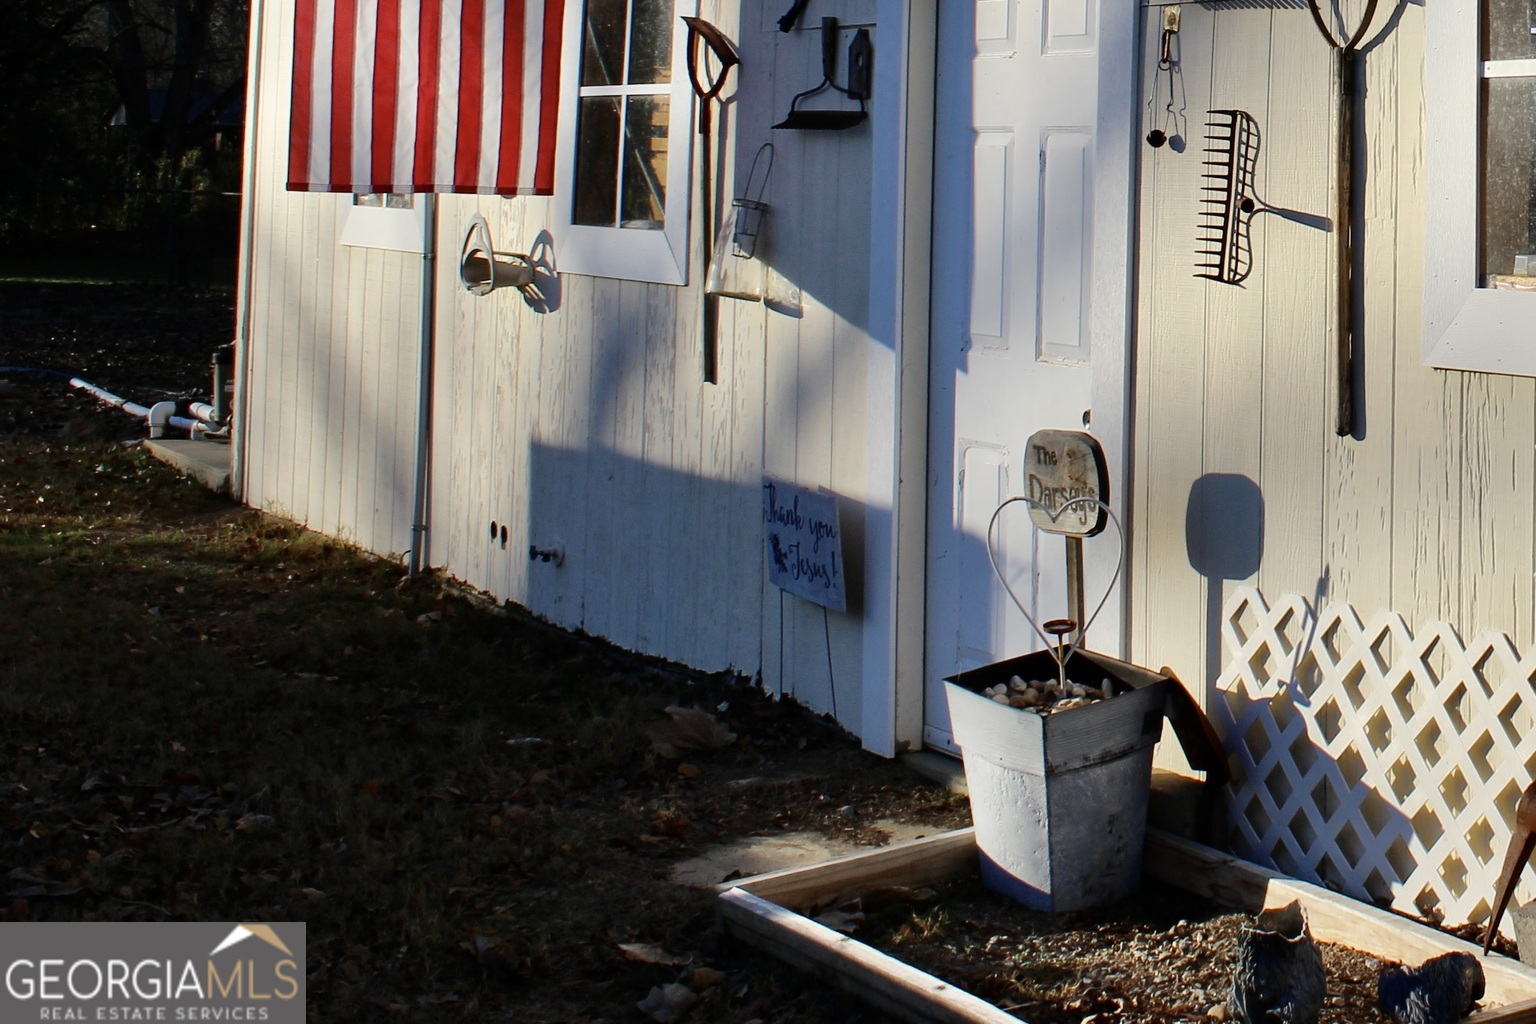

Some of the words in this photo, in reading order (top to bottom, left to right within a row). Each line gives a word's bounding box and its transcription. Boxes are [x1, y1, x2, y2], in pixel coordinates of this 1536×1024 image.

[1033, 444, 1058, 466] The
[763, 482, 805, 531] Thank
[809, 517, 837, 554] you
[788, 541, 838, 589] Jesus!
